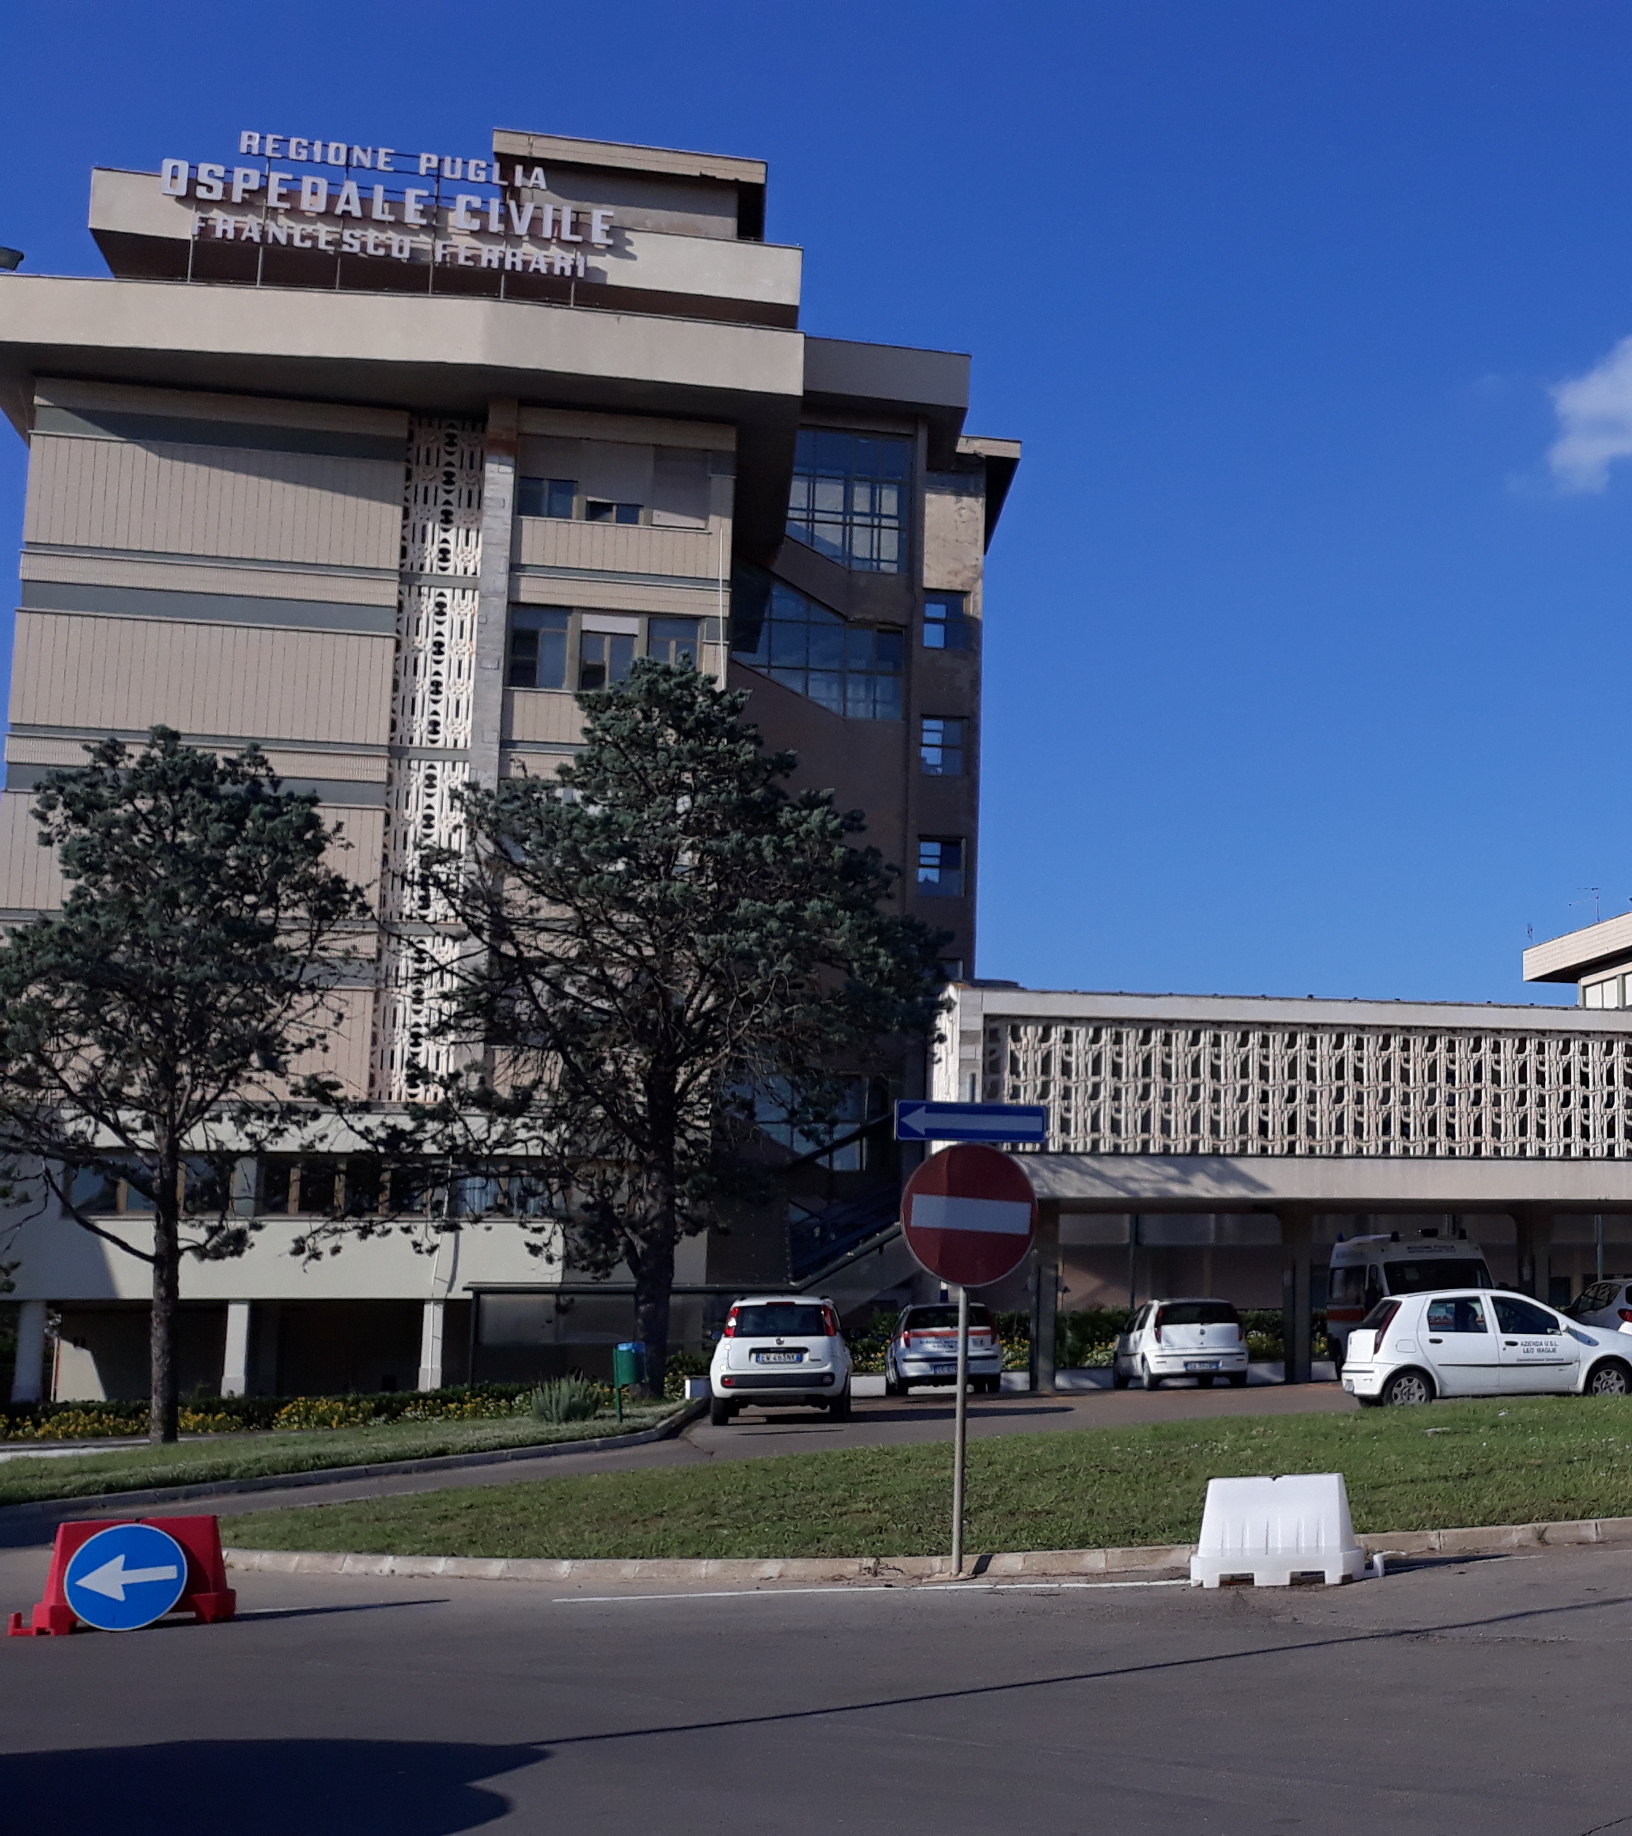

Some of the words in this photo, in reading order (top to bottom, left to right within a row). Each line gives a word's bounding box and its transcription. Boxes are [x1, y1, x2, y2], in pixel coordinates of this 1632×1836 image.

[239, 131, 395, 172] REGIONE
[419, 153, 548, 190] PUGLIA
[161, 158, 429, 226] OSPEDALE
[455, 193, 614, 246] CIVILE
[192, 213, 412, 262] FRANCESCO
[435, 242, 589, 278] FERRARI
